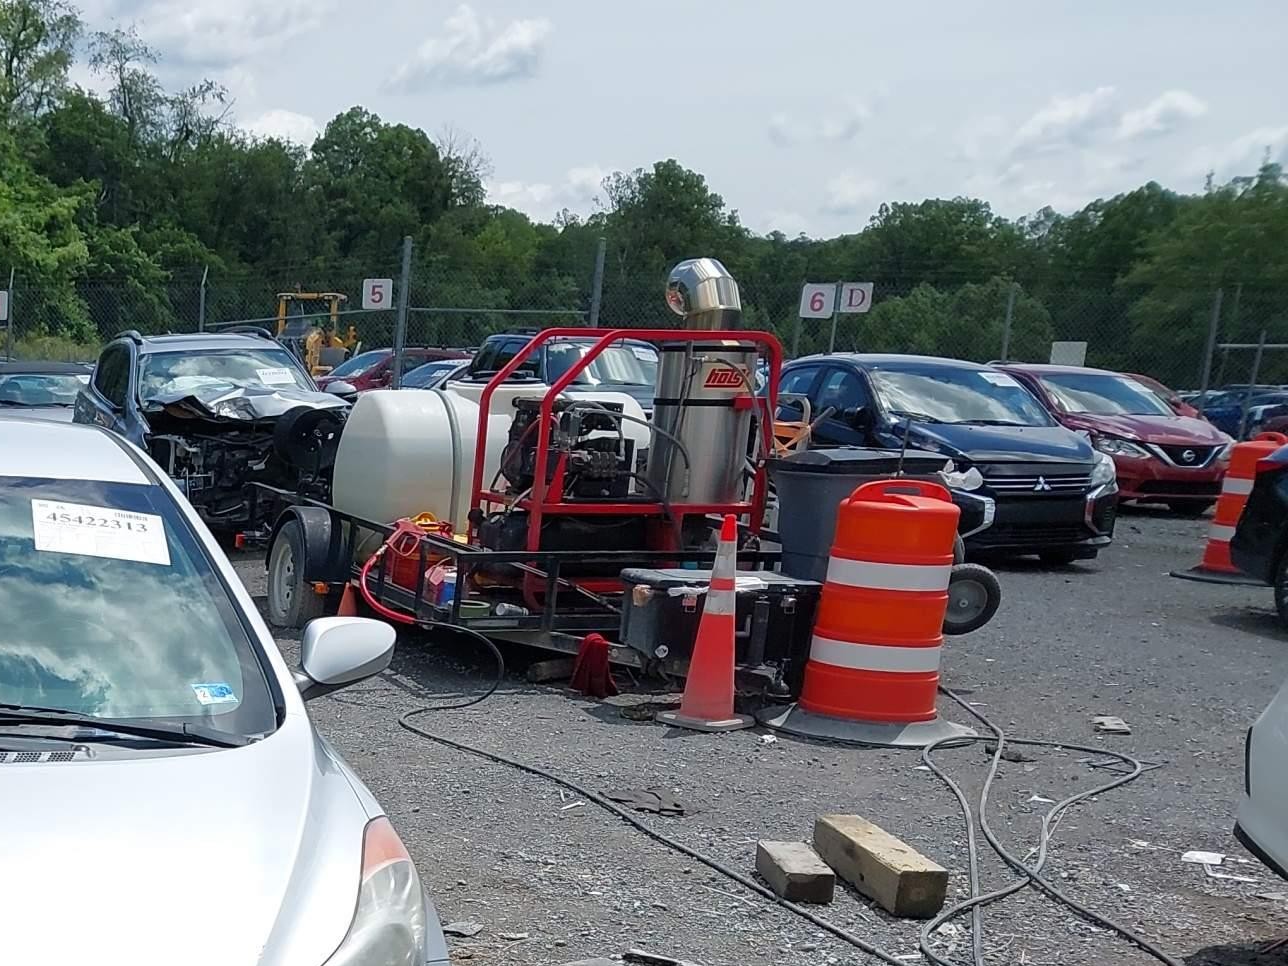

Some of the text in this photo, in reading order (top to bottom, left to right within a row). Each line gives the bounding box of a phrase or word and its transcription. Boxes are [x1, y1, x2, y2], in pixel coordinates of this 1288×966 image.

[371, 284, 383, 303] 5
[809, 292, 825, 312] 6
[847, 288, 866, 307] D
[46, 512, 148, 533] 45422313
